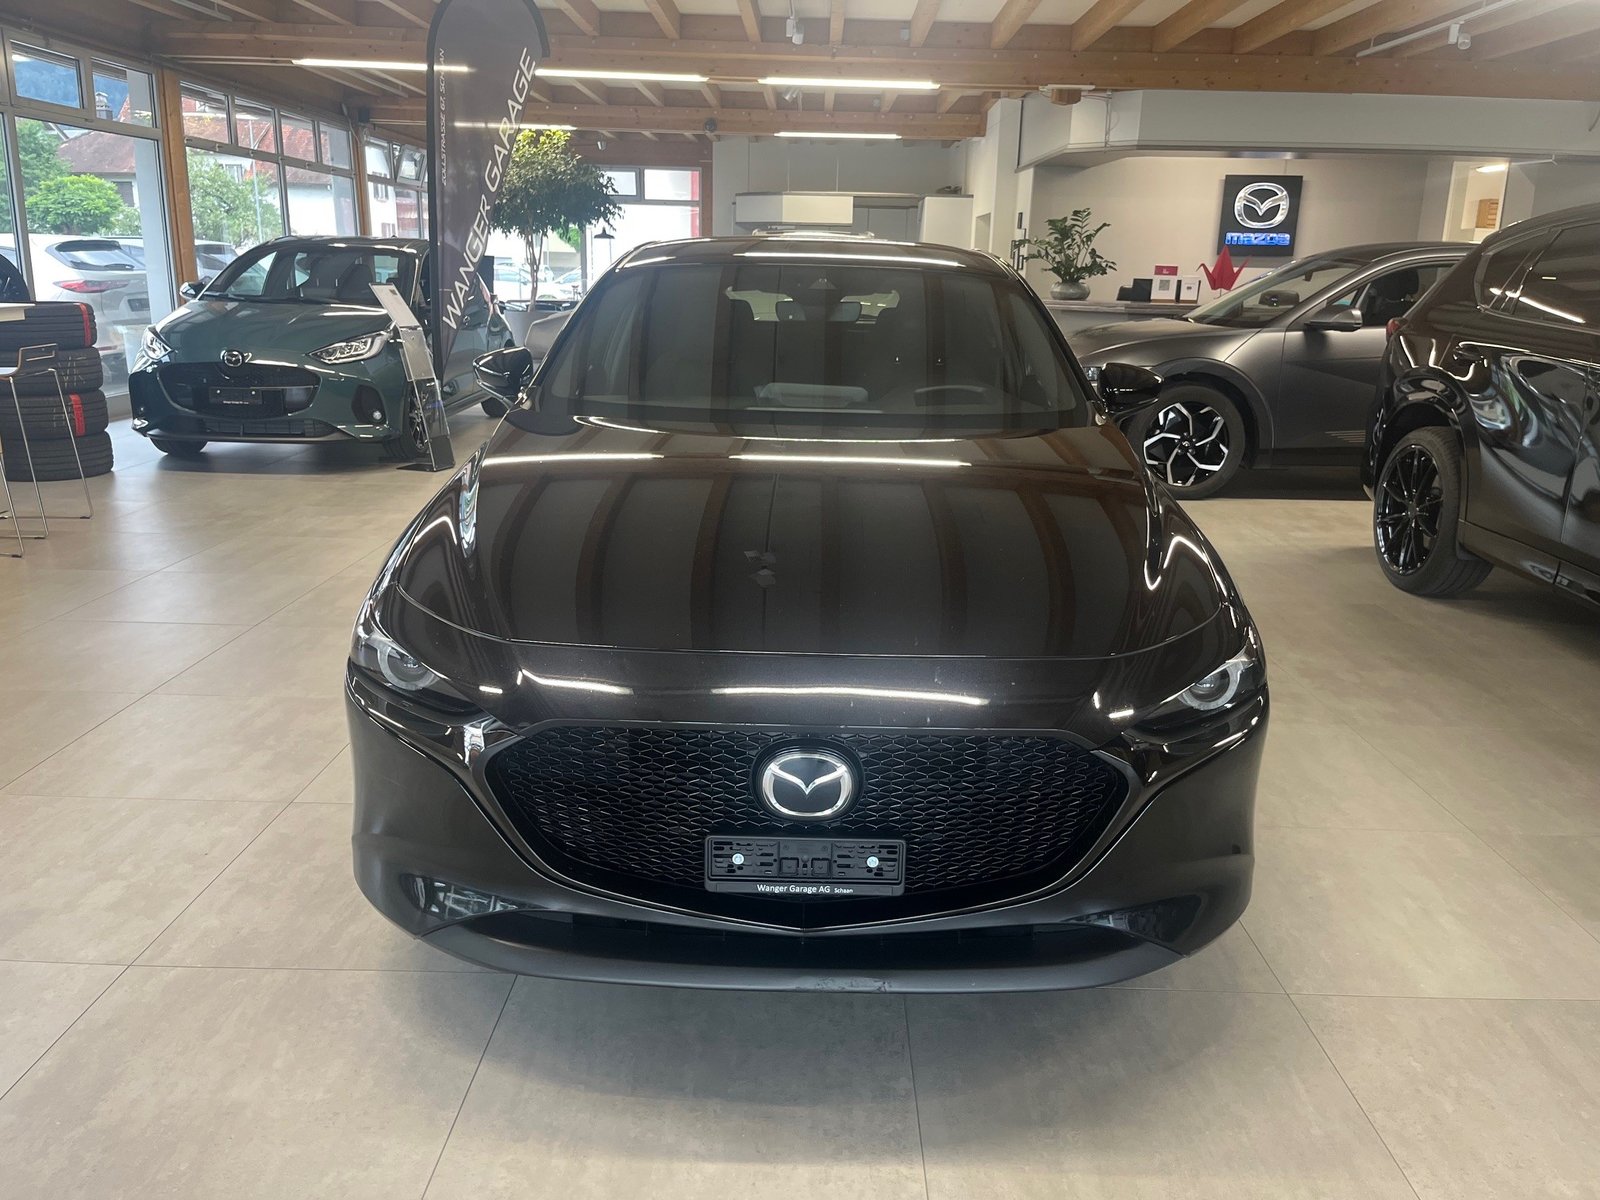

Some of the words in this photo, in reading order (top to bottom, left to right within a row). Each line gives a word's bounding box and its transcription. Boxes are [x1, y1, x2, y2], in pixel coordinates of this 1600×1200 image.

[442, 194, 491, 330] WANGER
[485, 47, 536, 193] GARAGE
[757, 884, 788, 894] Wanger
[789, 884, 817, 895] Garage
[818, 885, 831, 893] AG
